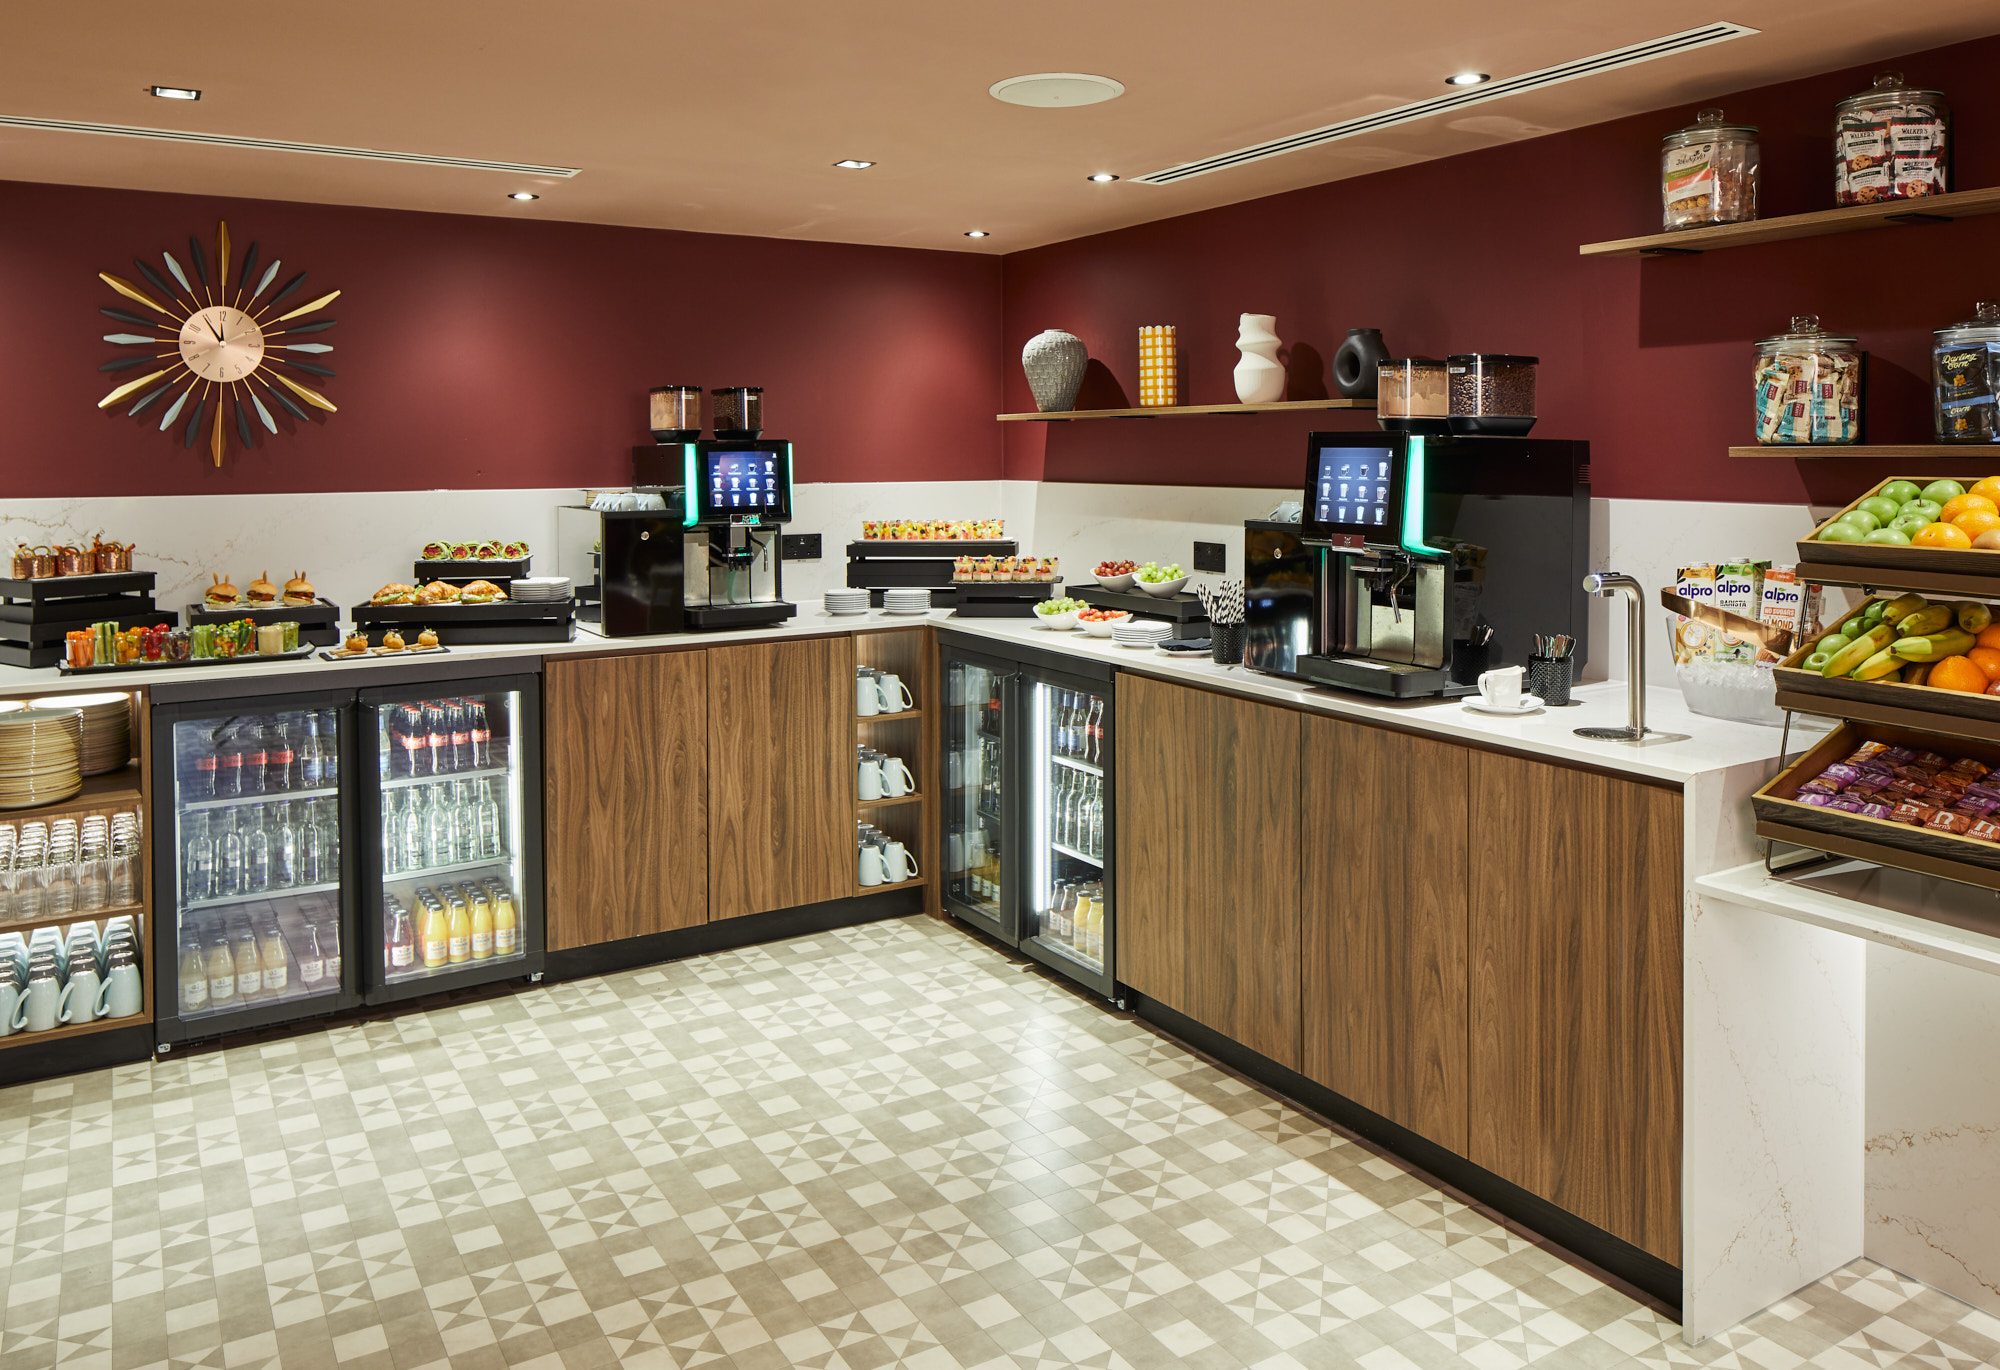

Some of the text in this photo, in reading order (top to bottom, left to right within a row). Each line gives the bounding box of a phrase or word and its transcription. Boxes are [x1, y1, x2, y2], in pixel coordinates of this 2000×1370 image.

[219, 310, 227, 322] 12
[236, 316, 243, 326] 1
[188, 323, 201, 334] 10
[244, 327, 256, 336] 2
[188, 353, 200, 362] 8
[202, 362, 211, 373] 7
[219, 366, 224, 378] 6
[234, 364, 243, 375] 5
[1678, 583, 1713, 599] alpro
[1717, 580, 1751, 597] alpro
[1764, 587, 1799, 604] alpro
[1719, 600, 1747, 608] BARISTA
[1773, 609, 1795, 617] SUGARS
